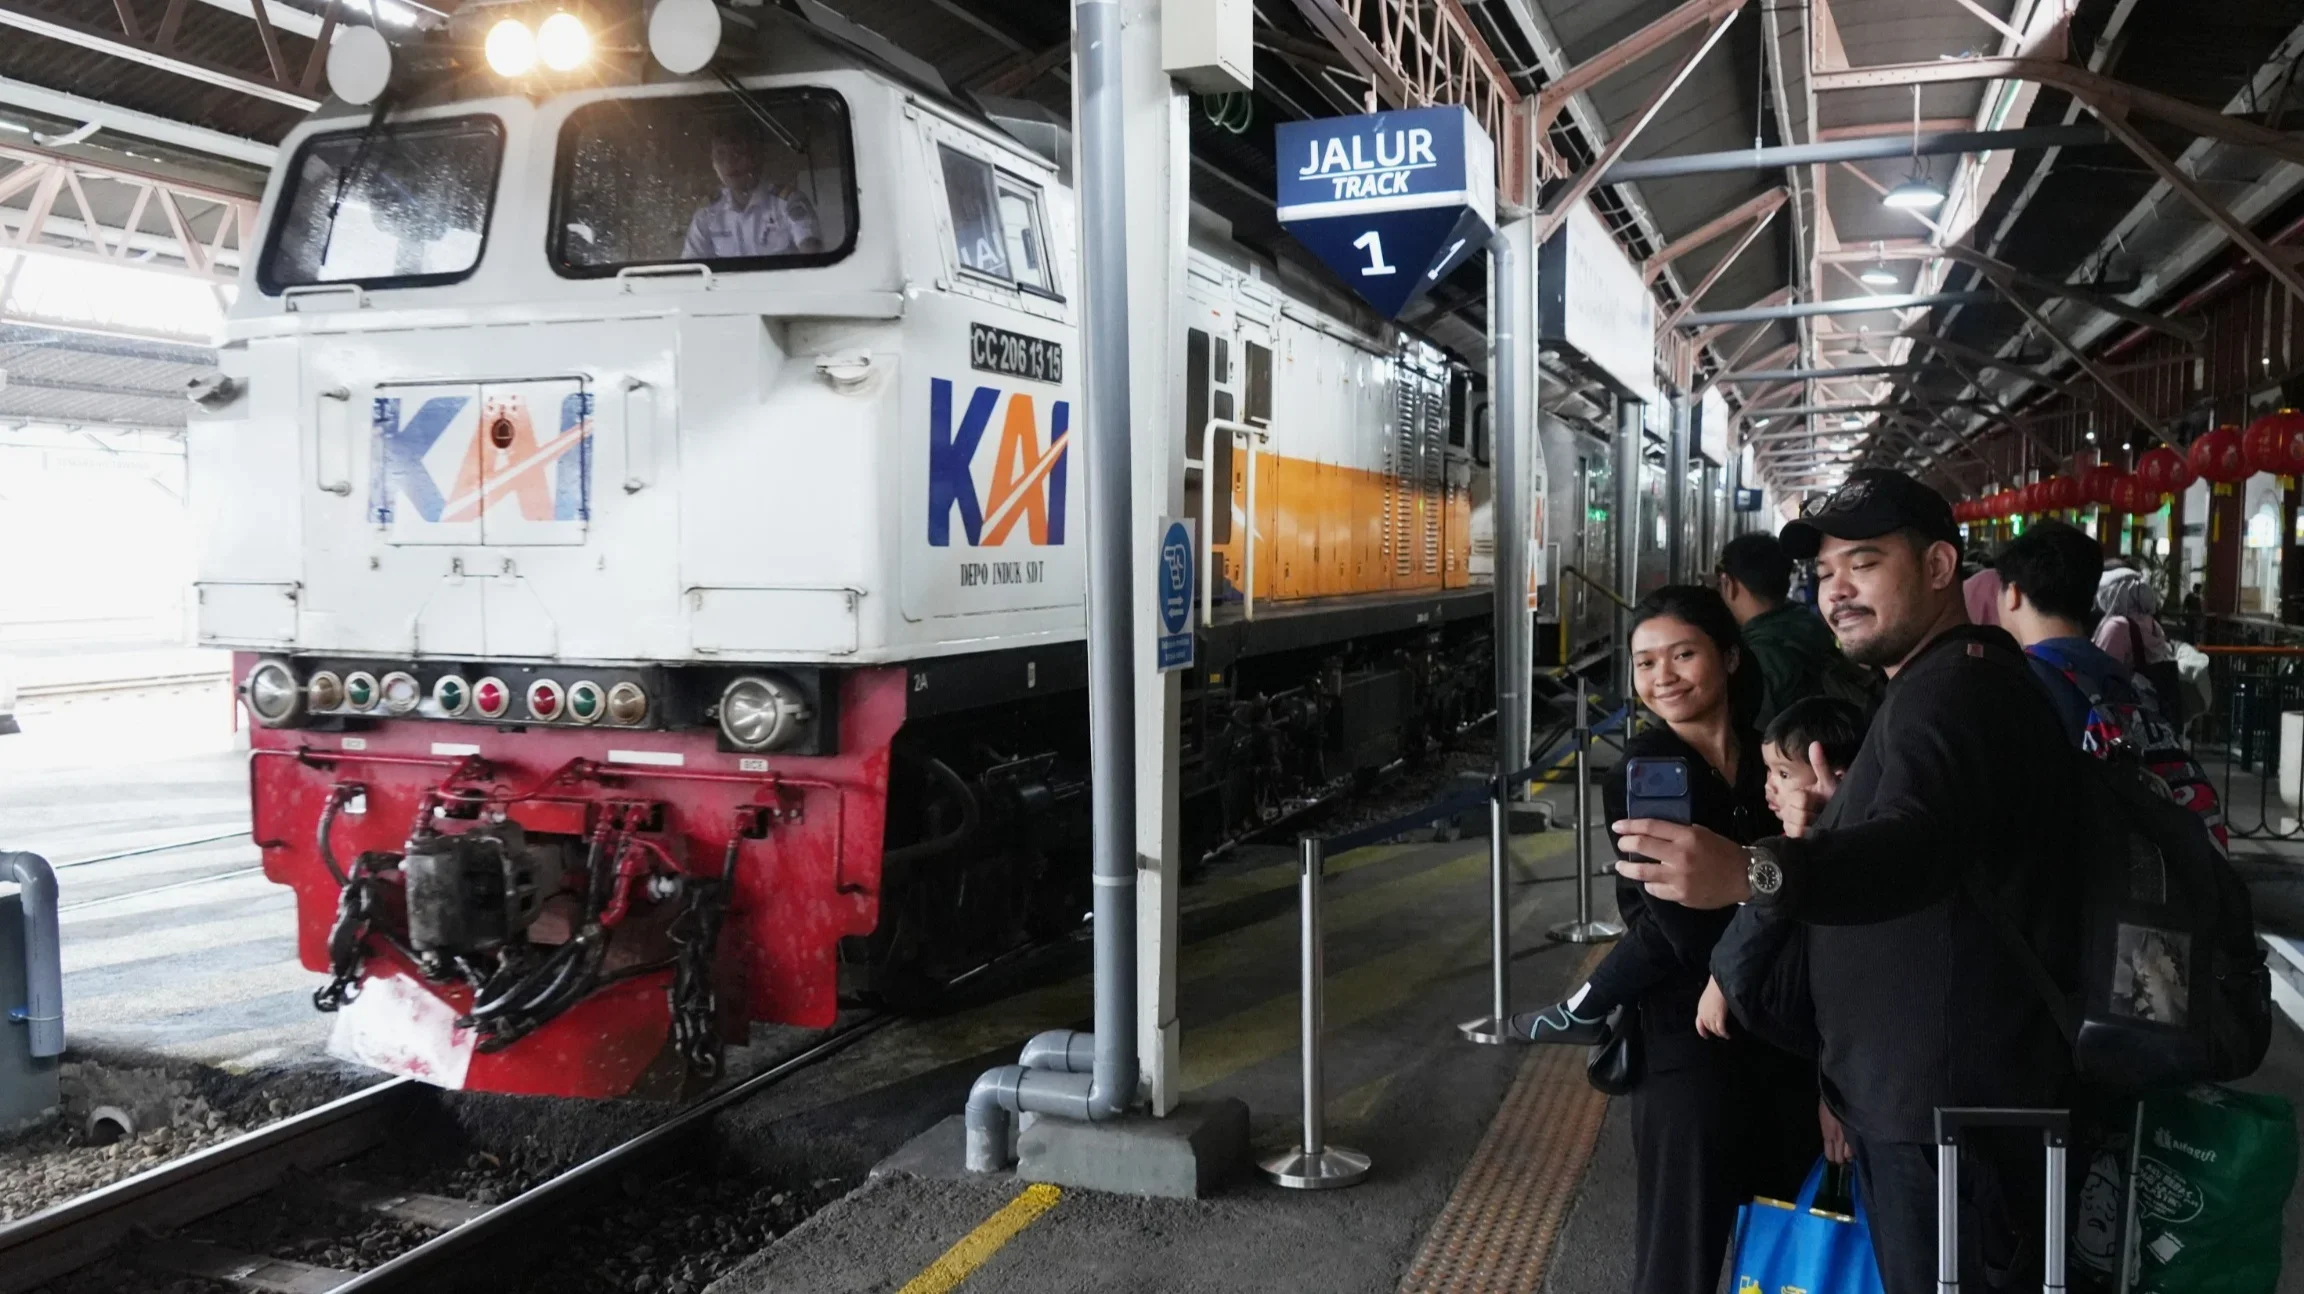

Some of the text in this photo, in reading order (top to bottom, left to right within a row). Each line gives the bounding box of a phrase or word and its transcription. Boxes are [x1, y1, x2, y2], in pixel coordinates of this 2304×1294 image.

[1299, 128, 1437, 175] JALUR
[1332, 170, 1411, 199] TRACK
[1353, 231, 1396, 276] 1
[973, 328, 1061, 380] CC 206 13 15
[367, 392, 594, 523] KAI
[928, 377, 1069, 547] KAI
[960, 561, 1044, 586] DEPO INDUK SDT
[914, 673, 928, 692] 2A
